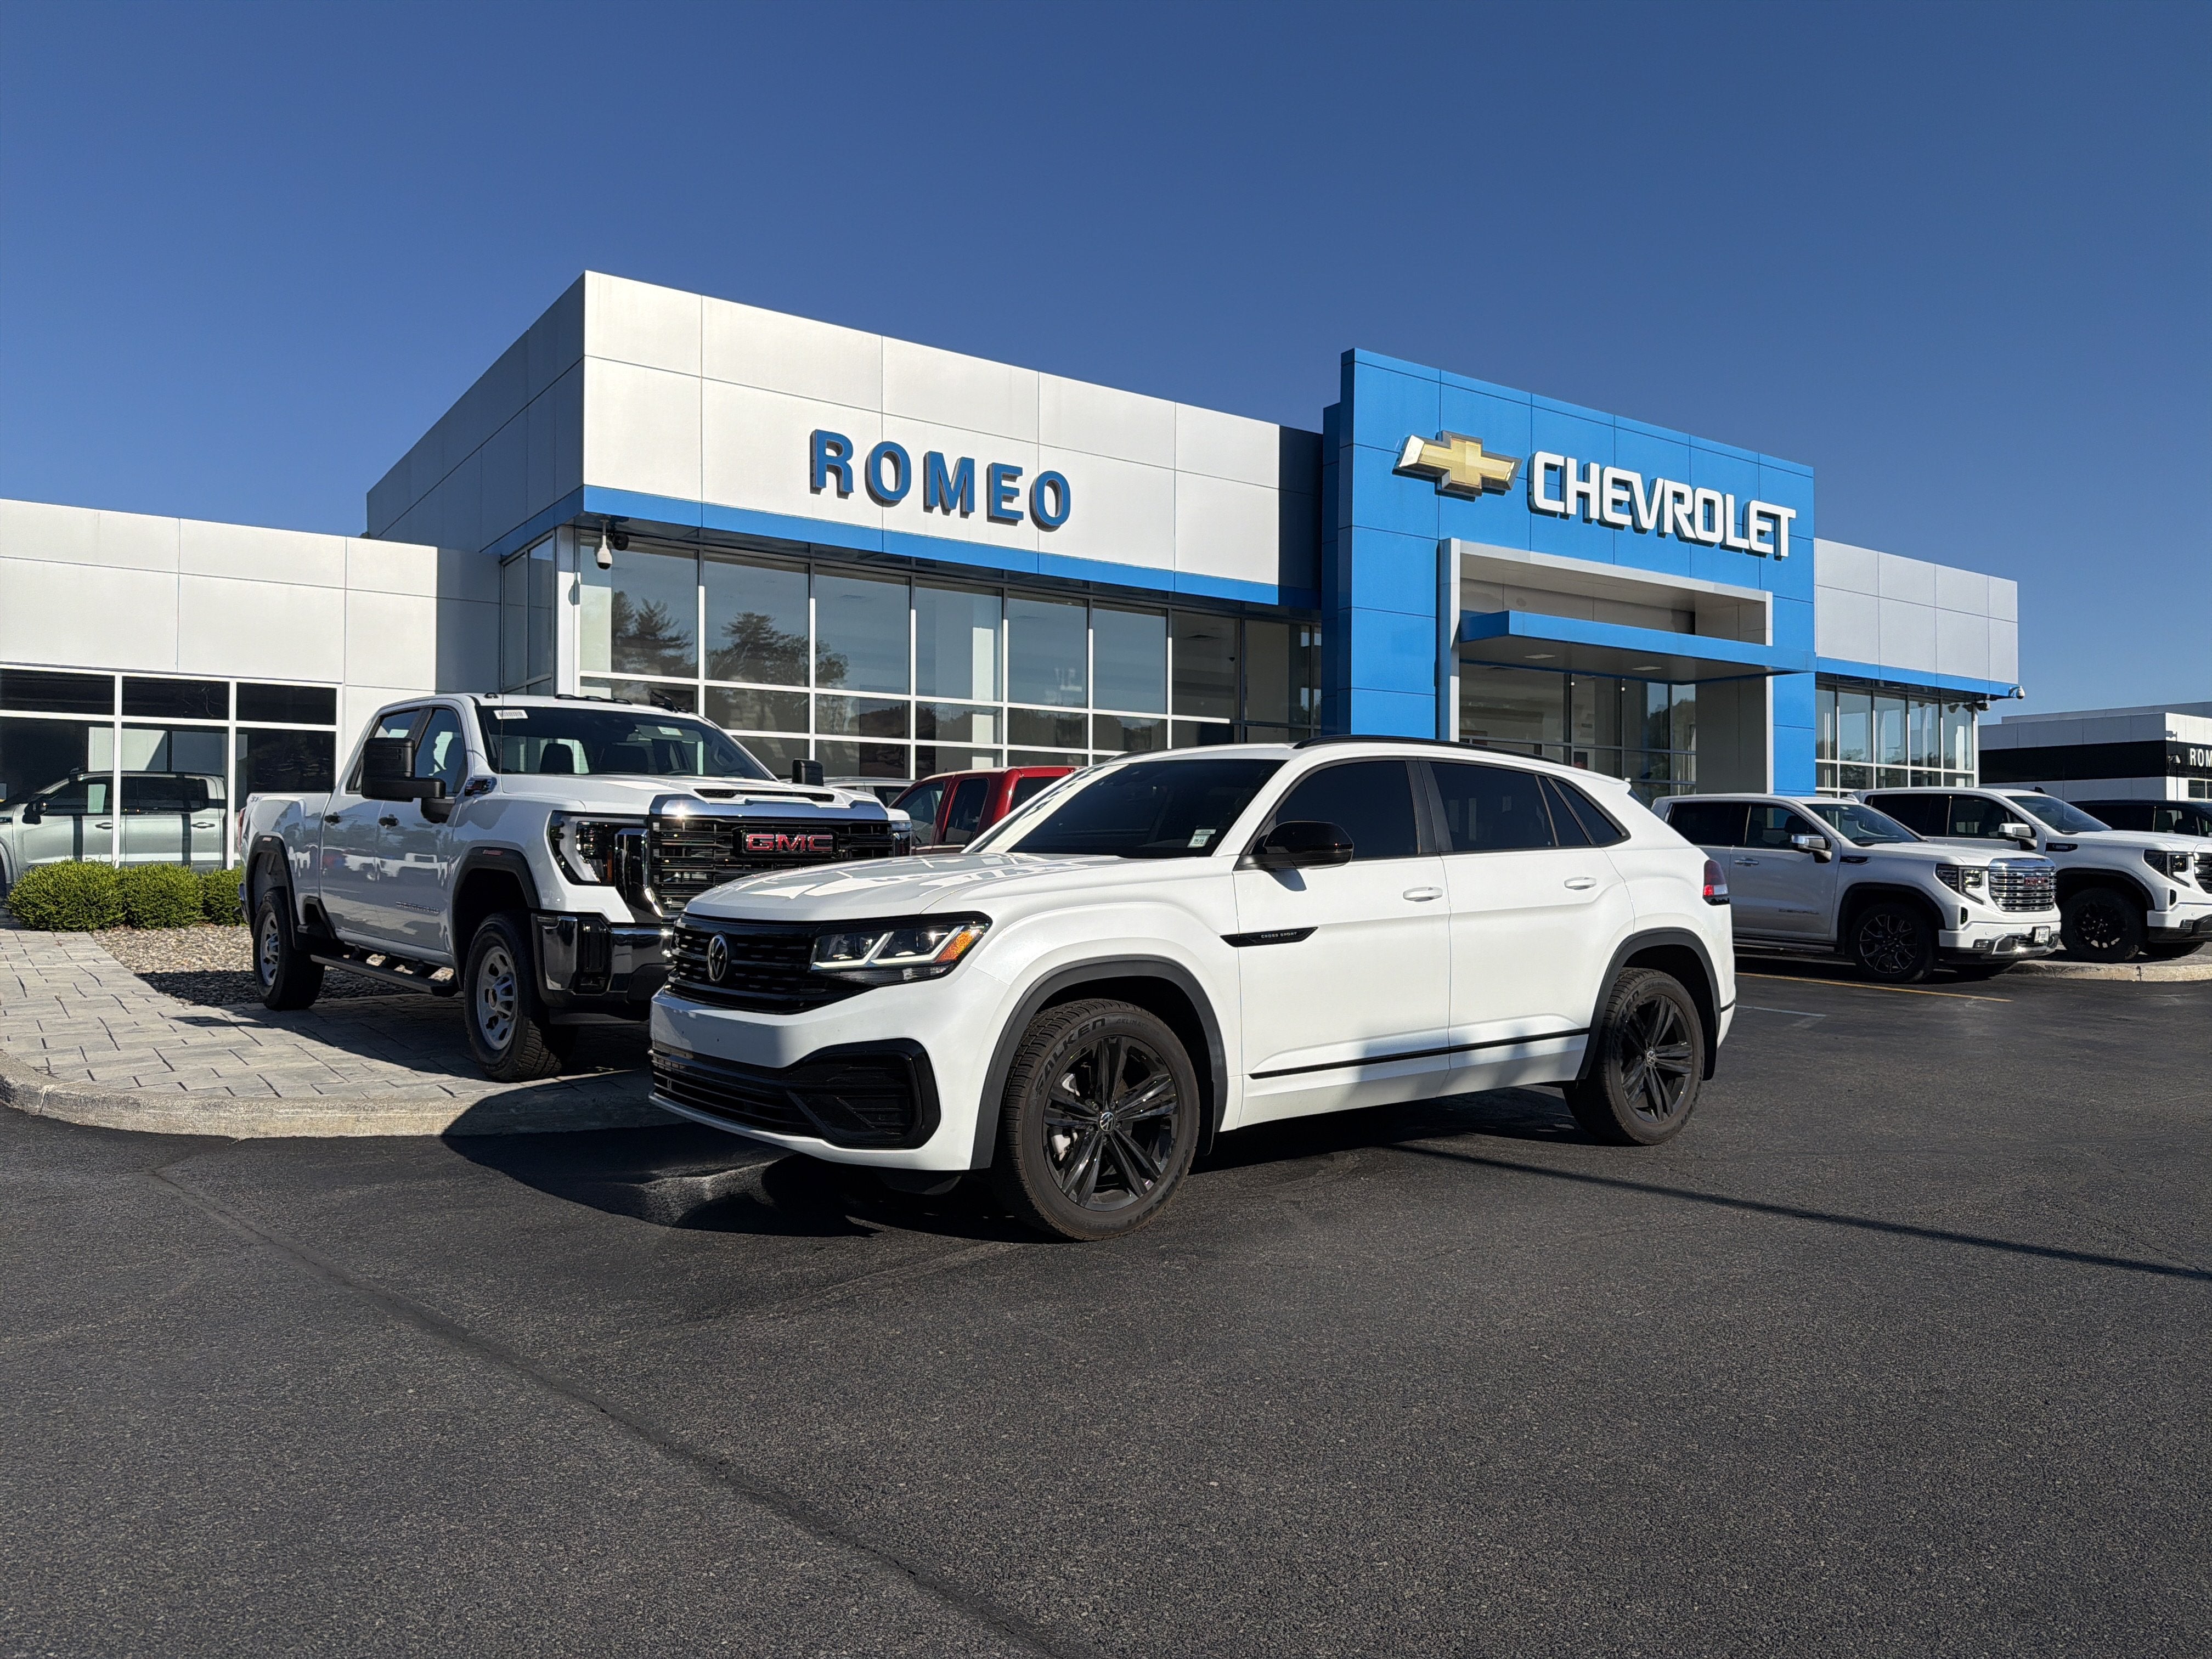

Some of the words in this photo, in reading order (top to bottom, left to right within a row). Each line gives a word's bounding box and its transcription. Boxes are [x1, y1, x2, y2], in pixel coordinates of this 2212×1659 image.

[810, 429, 1071, 531] ROMEO
[1529, 451, 1796, 559] CHEVROLET
[746, 833, 833, 851] GMC
[1034, 1017, 1106, 1096] FALKEN
